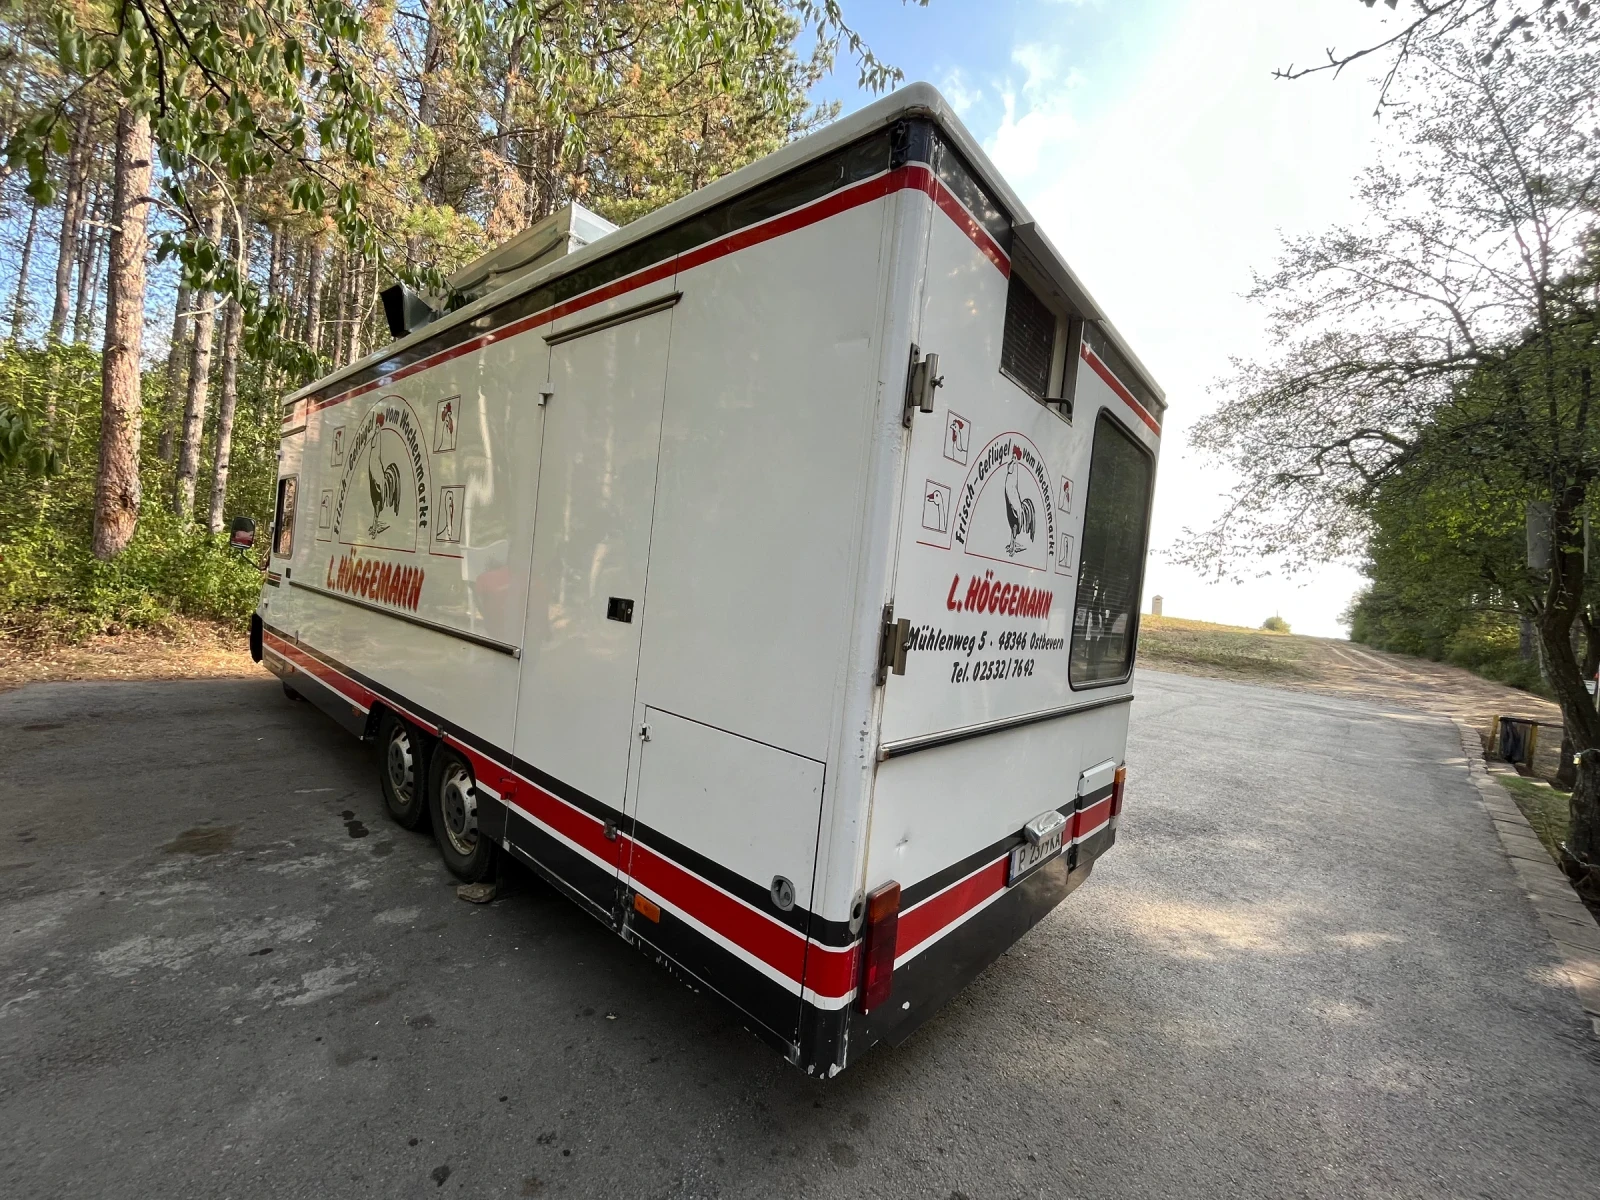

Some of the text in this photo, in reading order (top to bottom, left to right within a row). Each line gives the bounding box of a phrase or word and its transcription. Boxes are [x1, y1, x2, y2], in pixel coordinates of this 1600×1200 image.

[385, 407, 401, 425] vom
[399, 408, 429, 529] Wochenmarkt
[1022, 447, 1037, 470] vom
[1035, 462, 1055, 557] Wochenmarkt
[907, 624, 976, 658] Mühlenweg
[977, 630, 988, 651] 5
[998, 630, 1028, 651] 48346
[1029, 631, 1064, 651] Ostbevern
[950, 661, 970, 684] Tel.
